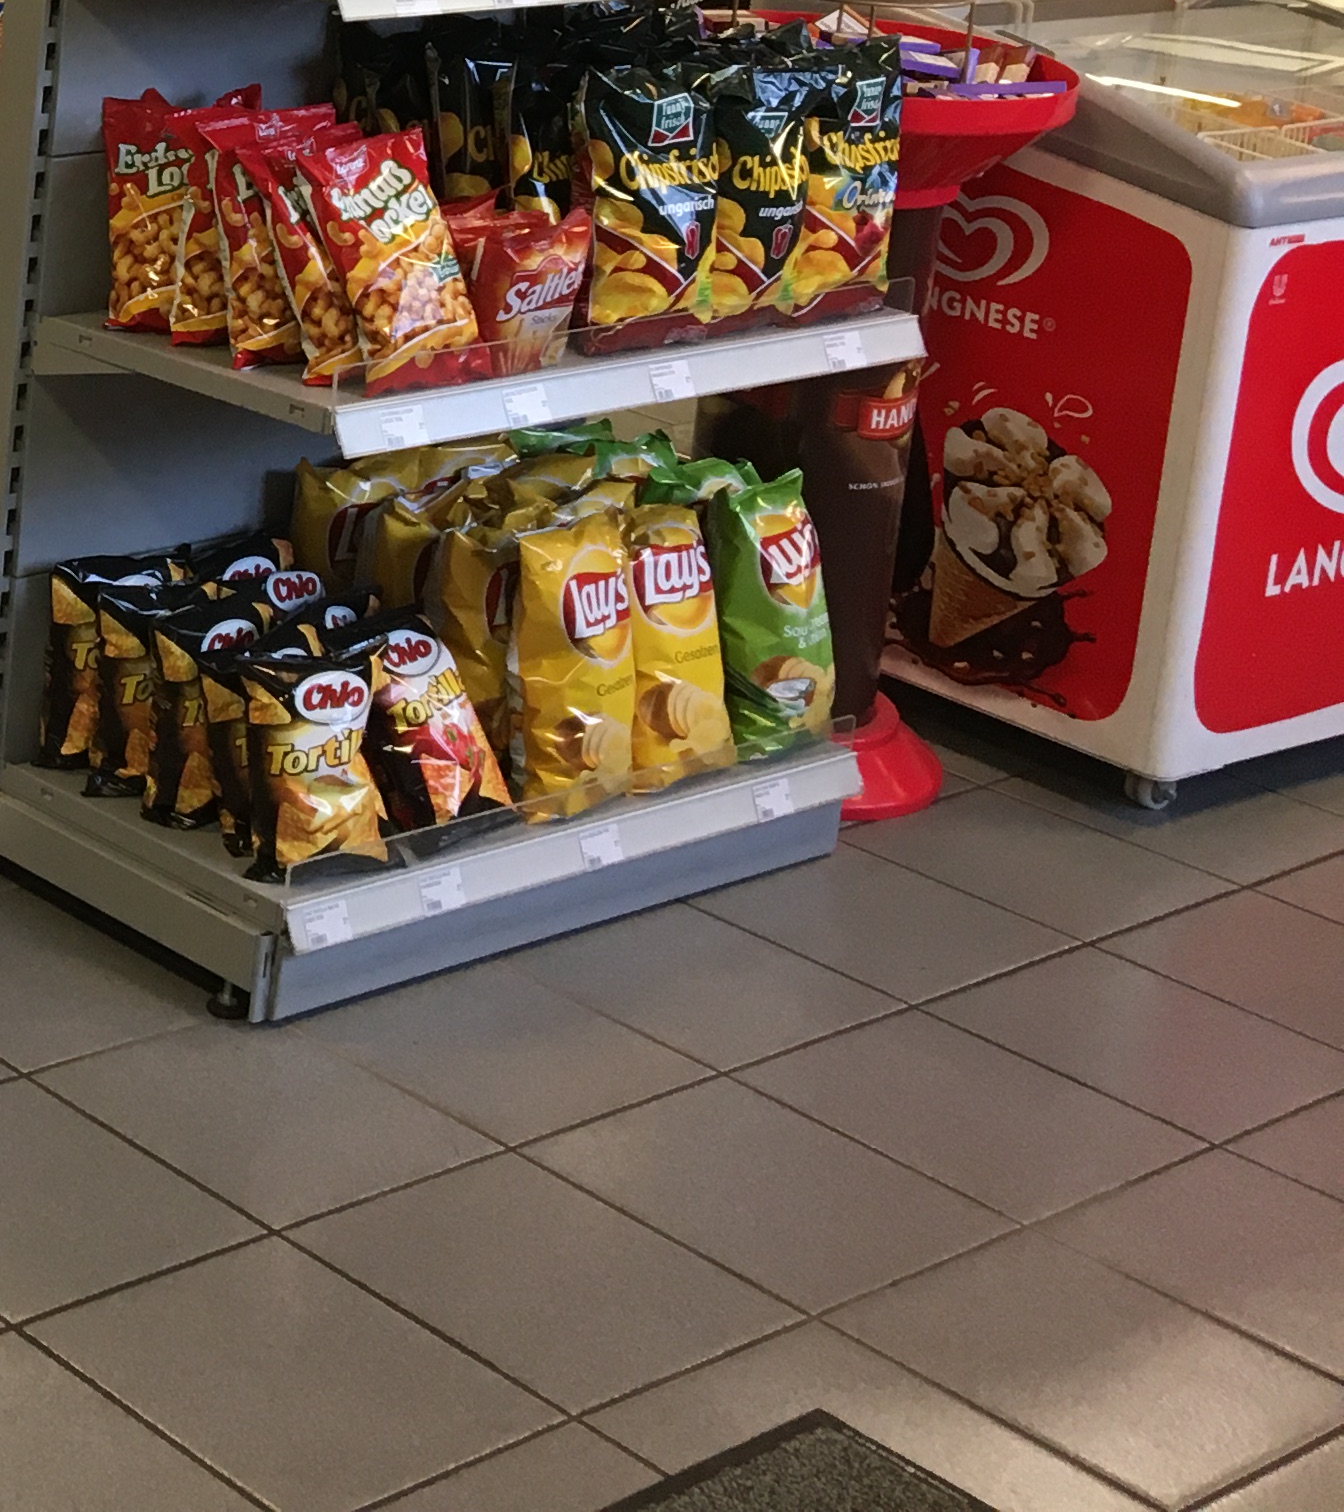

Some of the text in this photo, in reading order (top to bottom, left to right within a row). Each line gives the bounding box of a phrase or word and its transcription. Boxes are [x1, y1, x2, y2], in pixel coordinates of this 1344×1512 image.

[272, 576, 317, 605] Chio
[639, 543, 711, 606] Lay's
[569, 570, 629, 638] Lay's
[302, 680, 364, 713] Chio
